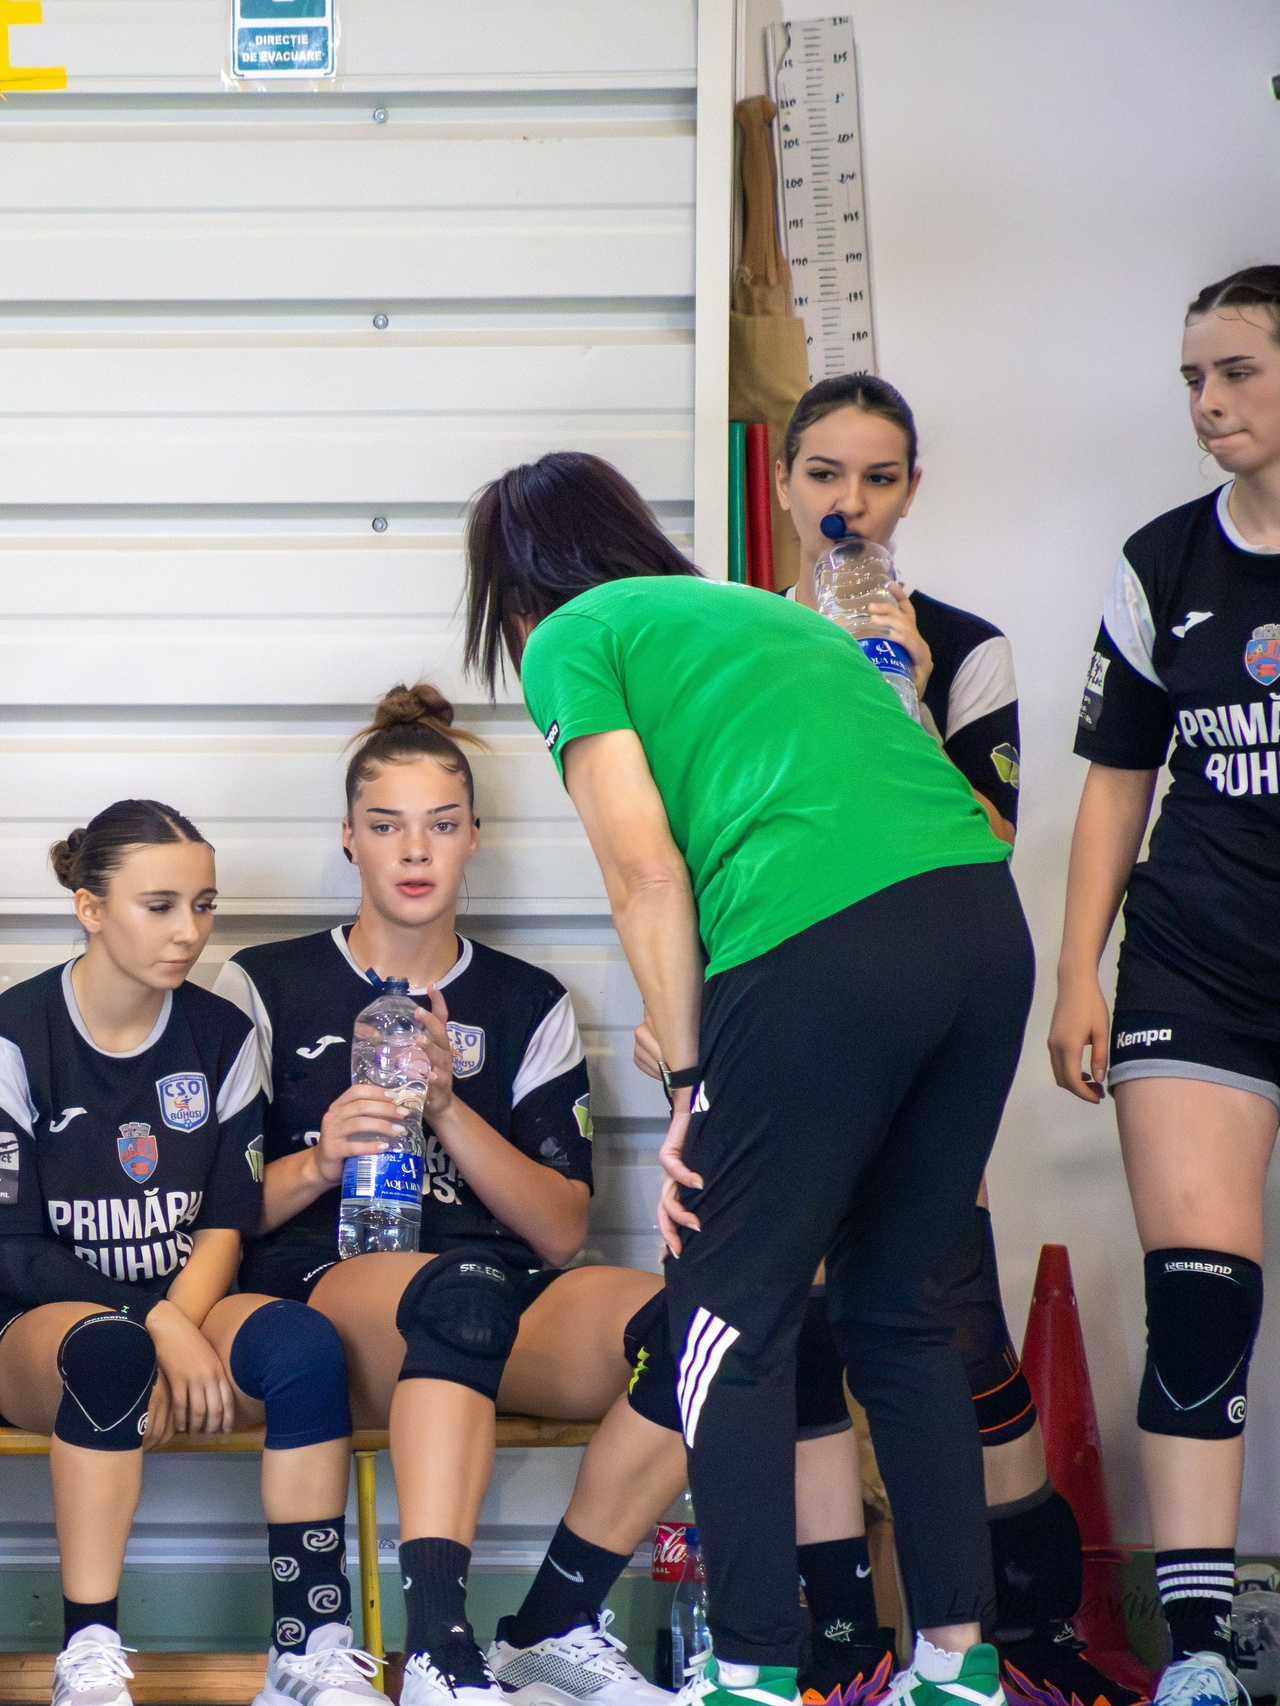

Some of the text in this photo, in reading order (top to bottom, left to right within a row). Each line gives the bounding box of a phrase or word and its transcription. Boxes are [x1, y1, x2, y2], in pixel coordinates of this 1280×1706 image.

[242, 50, 322, 62] DE EVACUARE
[1116, 1028, 1173, 1050] Kempa
[164, 1080, 201, 1098] CSO
